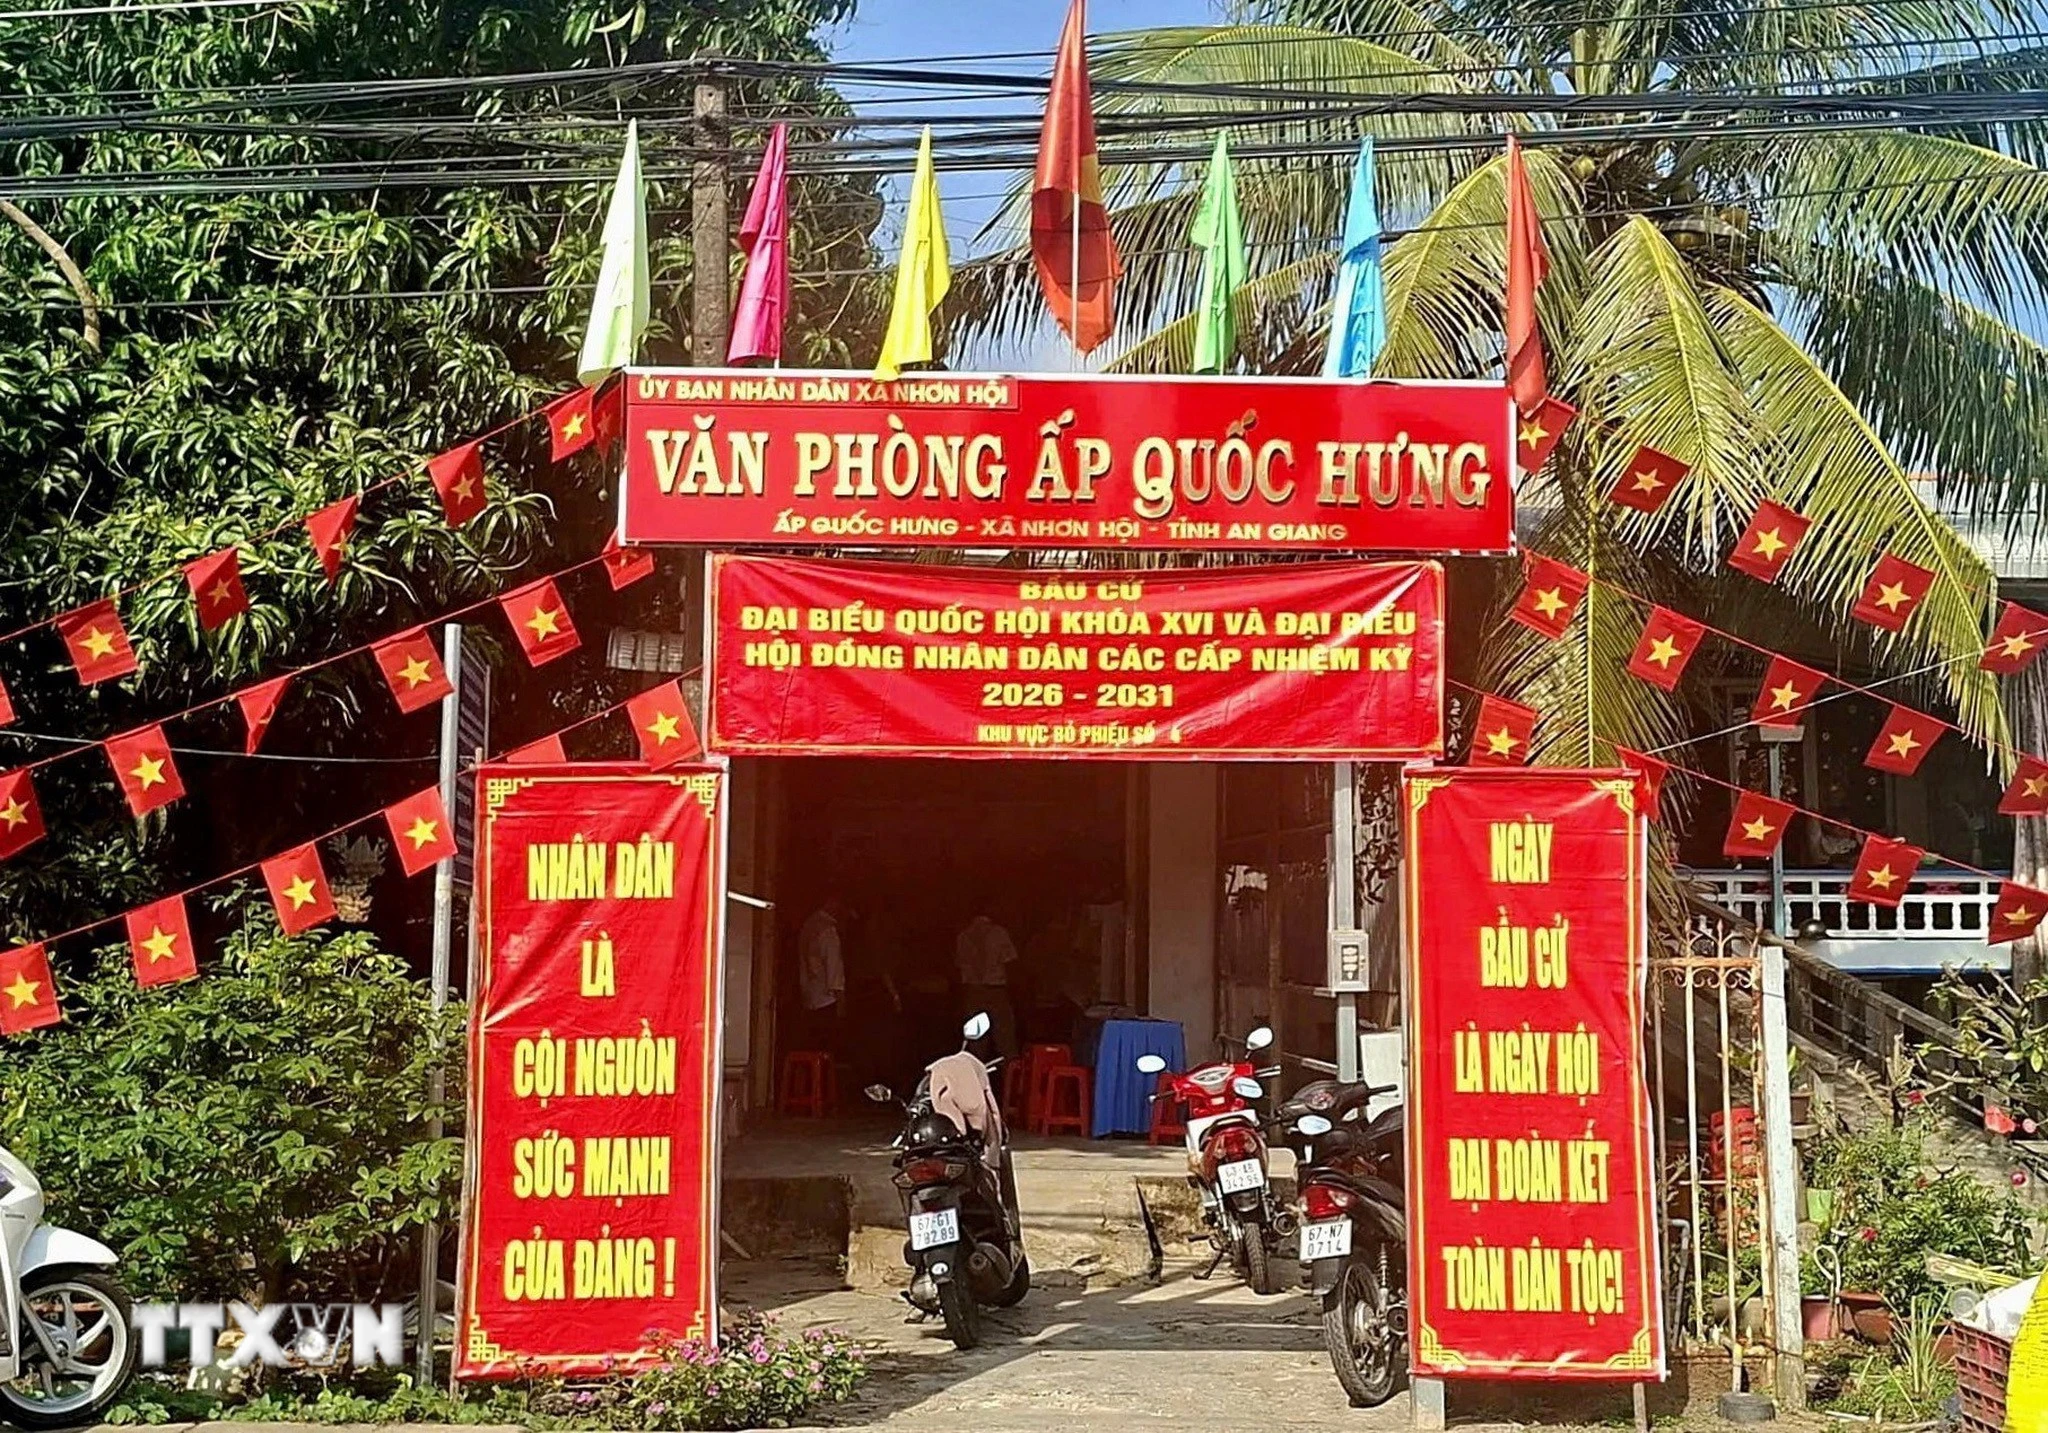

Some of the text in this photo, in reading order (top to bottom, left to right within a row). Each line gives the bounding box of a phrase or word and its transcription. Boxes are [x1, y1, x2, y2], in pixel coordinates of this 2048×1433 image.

[637, 374, 672, 401] ỦY
[675, 379, 724, 401] BAN
[729, 377, 796, 401] NHÂN
[801, 378, 850, 403] DÂN
[893, 381, 960, 404] NHƠN
[966, 379, 1009, 408] HỘI
[645, 407, 1492, 519] VĂN PHÒNG ẤP QUỐC HƯNG
[772, 507, 807, 534] ẤP
[810, 508, 884, 536] QUỐC
[890, 516, 959, 535] HƯNG
[981, 515, 1016, 537] XÃ
[1021, 518, 1090, 538] NHƠN
[1099, 517, 1141, 544] HỘI
[1167, 515, 1220, 539] TỈNH
[1226, 523, 1261, 541] AN
[1268, 523, 1348, 541] GIANG
[741, 606, 798, 635] ĐẠI
[808, 600, 885, 633] BIỂU
[894, 601, 984, 636] QUỐC
[995, 605, 1051, 639] HỘI
[1060, 606, 1151, 635] KHÓA
[1160, 611, 1214, 635] XVI
[1223, 608, 1267, 636] VÀ
[1274, 612, 1331, 640] ĐẠI
[745, 637, 1413, 677] HỘI ĐỒNG NHÂN DÂN CÁC CẤP NHIỆM KỲ
[982, 683, 1063, 707] 2026
[1097, 683, 1173, 707] 2031
[977, 724, 1012, 743] KHU
[1016, 725, 1049, 747] VỰC
[528, 832, 674, 901] NHÂN DÂN
[1490, 814, 1553, 884] NGÀY
[581, 931, 615, 997] LÀ
[1480, 906, 1569, 989] BẦU CỬ
[513, 1018, 676, 1108] CỘI NGUỒN
[1455, 1022, 1599, 1106] LÀ NGÀY HỘI
[513, 1129, 670, 1207] SỨC MẠNH
[1448, 1120, 1610, 1212] ĐẠI ĐOÀN KẾT
[503, 1225, 676, 1301] CỦA ĐẢNG !
[1442, 1237, 1624, 1325] TOÀN DÂN TỘC!
